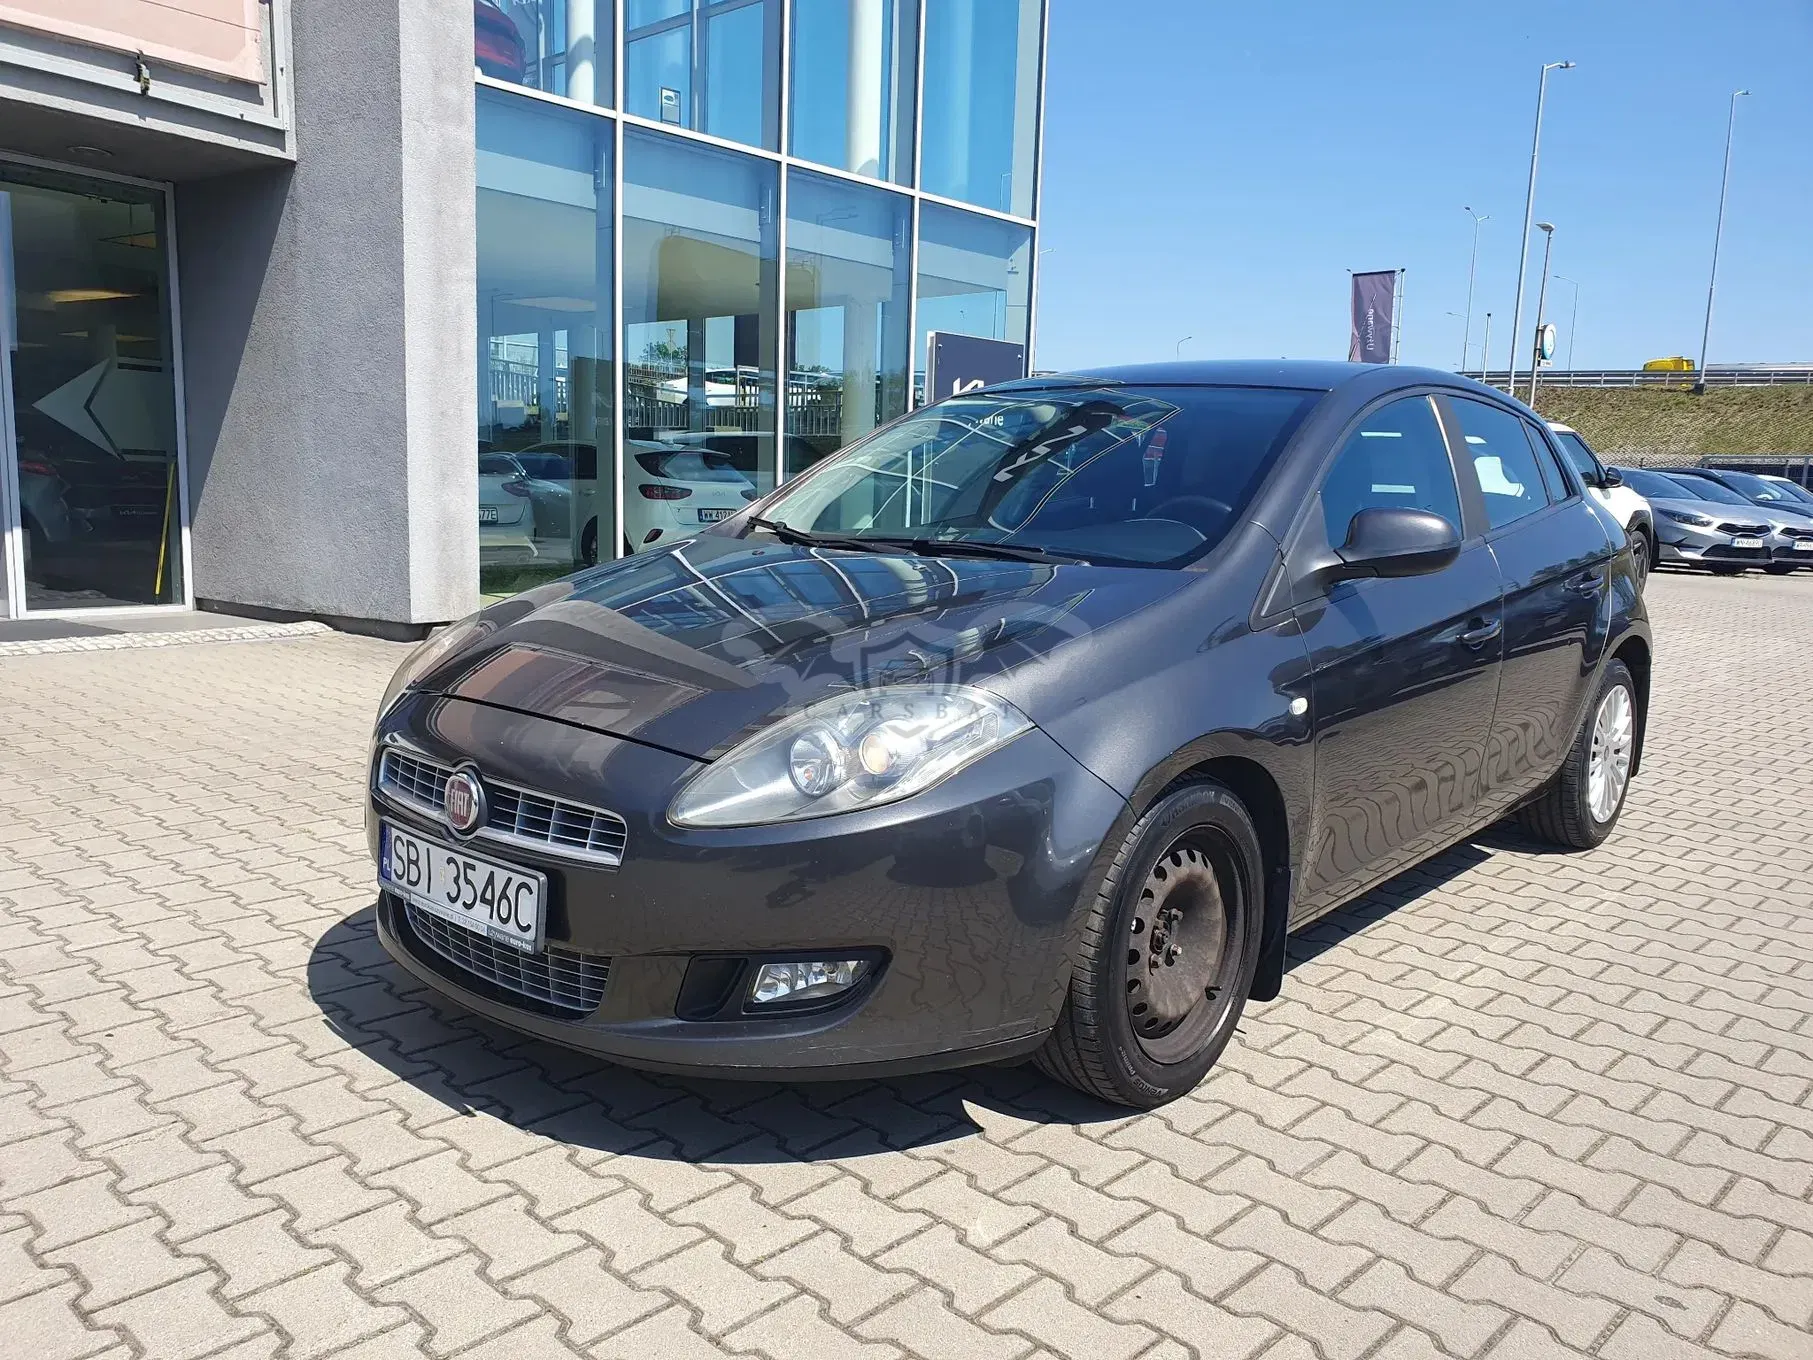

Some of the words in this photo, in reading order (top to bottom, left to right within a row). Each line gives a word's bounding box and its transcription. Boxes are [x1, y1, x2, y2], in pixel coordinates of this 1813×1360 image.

[450, 789, 470, 817] FIAT
[383, 858, 391, 871] PL
[393, 835, 431, 894] SBI
[446, 856, 534, 933] 3546C
